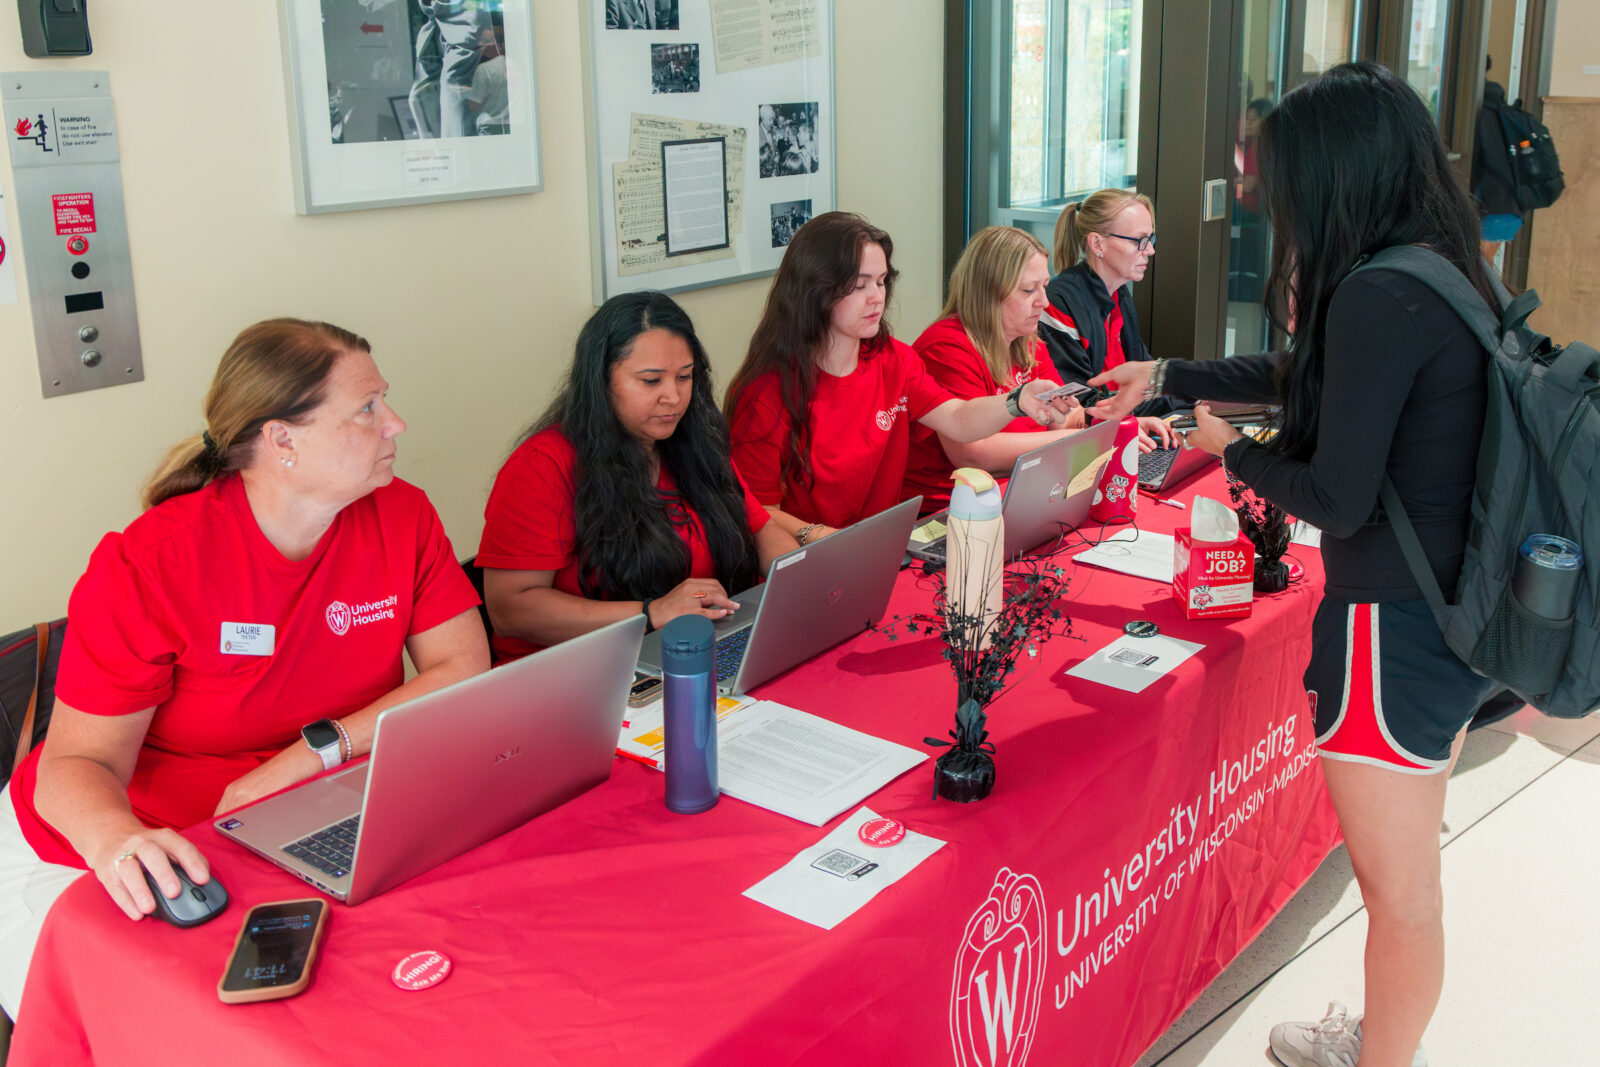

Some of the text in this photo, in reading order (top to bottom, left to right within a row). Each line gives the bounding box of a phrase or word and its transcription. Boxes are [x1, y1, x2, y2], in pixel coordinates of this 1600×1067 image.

[1206, 550, 1245, 560] NEED A
[1206, 560, 1246, 573] JOB?
[350, 595, 398, 615] University
[352, 608, 395, 626] Housing
[236, 625, 262, 636] LAURIE
[868, 820, 897, 842] HIRING!
[1057, 713, 1298, 957] University Housing
[1055, 885, 1161, 1010] UNIVERSITY
[1164, 860, 1187, 900] OF
[401, 954, 443, 984] HIRING!
[974, 941, 1026, 1067] W
